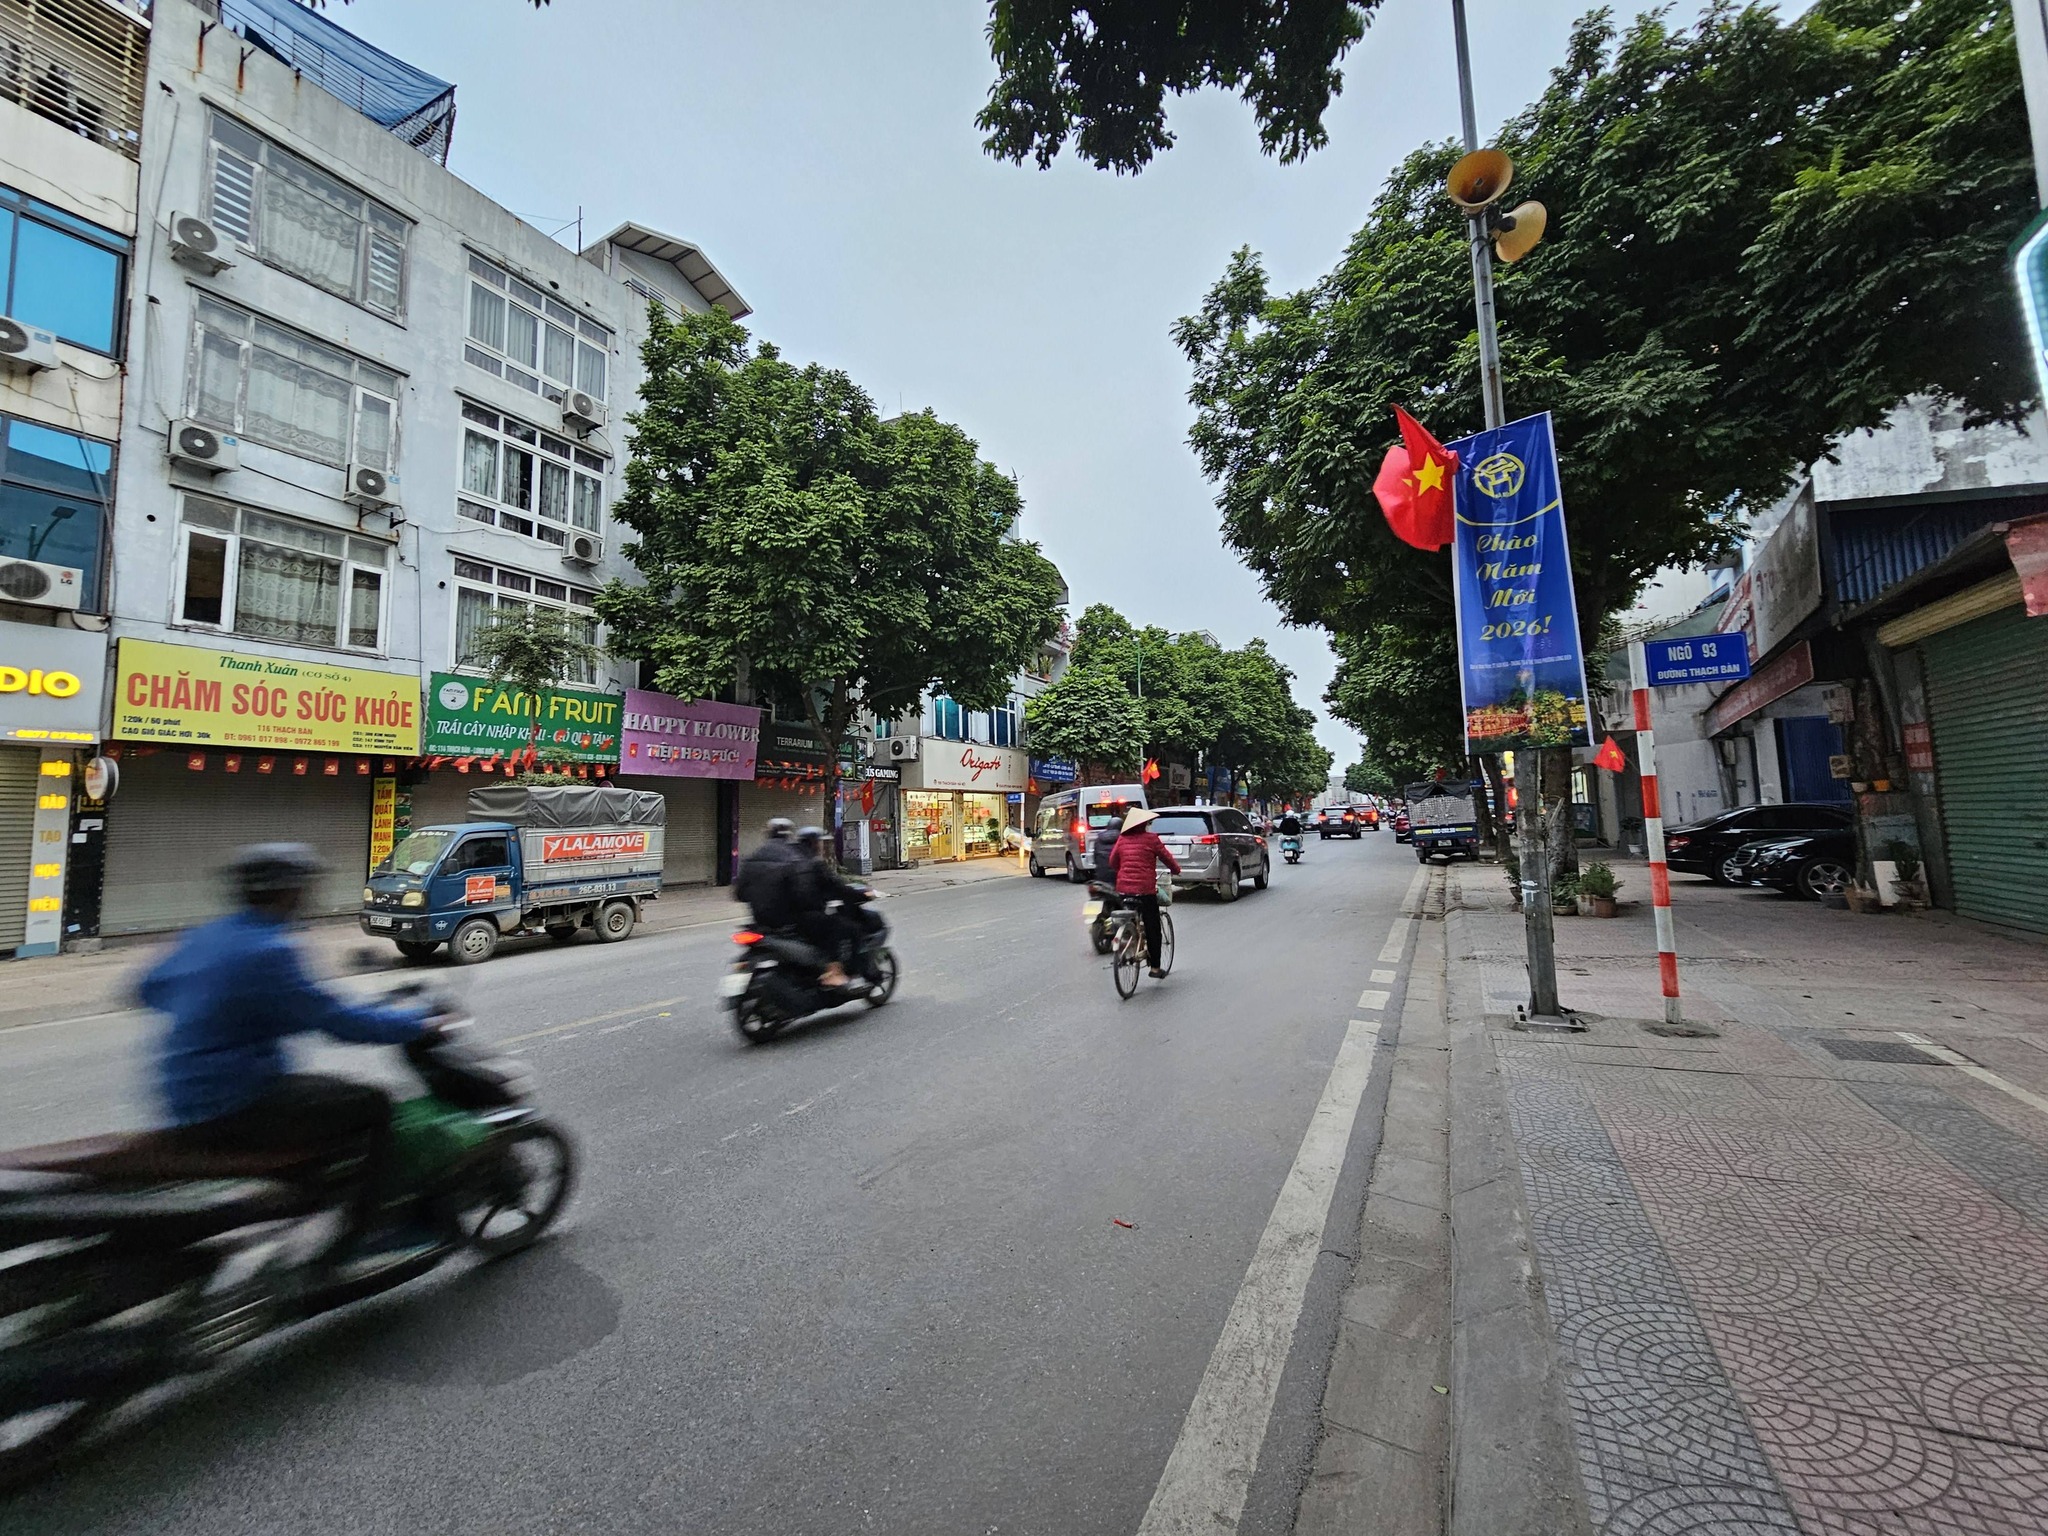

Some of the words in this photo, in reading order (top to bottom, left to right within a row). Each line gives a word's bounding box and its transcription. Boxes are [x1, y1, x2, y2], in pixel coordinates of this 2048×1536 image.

[1476, 533, 1539, 553] Chào
[1476, 561, 1544, 581] Năm
[1485, 588, 1537, 609] Mới
[1480, 615, 1552, 641] 2026!
[1668, 642, 1692, 661] NGÕ
[1702, 642, 1718, 658] 93
[220, 656, 262, 672] Thanh
[264, 662, 298, 676] Xuân
[1658, 668, 1688, 680] ĐƯỜNG
[1689, 665, 1718, 678] THẠCH
[1720, 662, 1740, 674] BÀN
[127, 670, 222, 712] CHĂM
[232, 680, 287, 718] SÓC
[296, 686, 346, 723] SỨC
[354, 690, 413, 728] KHỎE
[473, 687, 541, 718] FAM
[549, 696, 617, 724] FRUIT
[436, 719, 462, 734] TRÁI
[463, 720, 486, 736] CÂY
[486, 723, 517, 740] NHẬP
[623, 712, 690, 736] HAPPY
[693, 721, 760, 742] FLOWER
[776, 736, 813, 748] TERRARIUM
[562, 835, 644, 851] LALAMOVE
